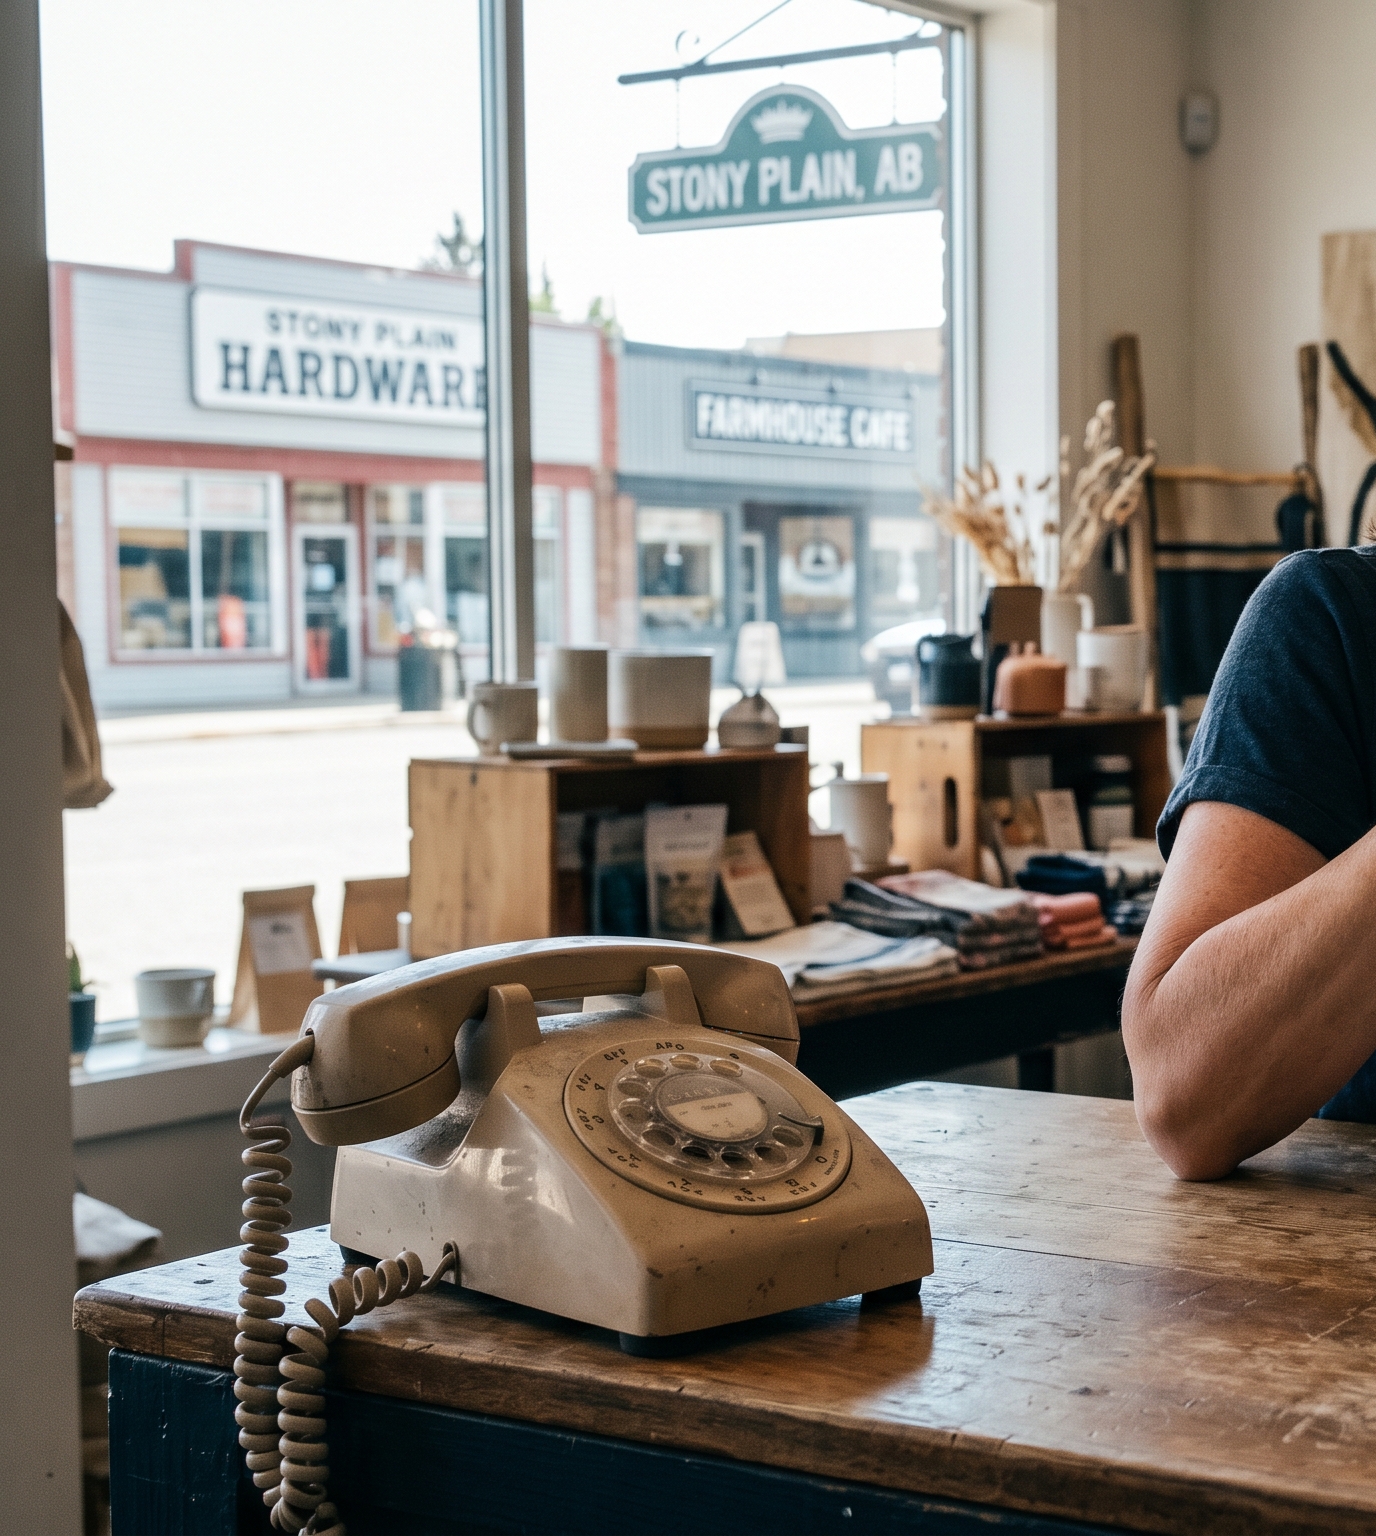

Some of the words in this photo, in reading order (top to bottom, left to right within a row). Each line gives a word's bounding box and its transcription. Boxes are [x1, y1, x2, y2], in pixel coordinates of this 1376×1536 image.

[646, 160, 750, 216] STONY
[758, 149, 865, 206] PLAIN,
[874, 142, 923, 195] AB
[266, 310, 362, 341] STONY
[375, 322, 456, 350] PLAIN
[697, 392, 849, 448] FARMHOUSE
[851, 407, 911, 451] CAFE
